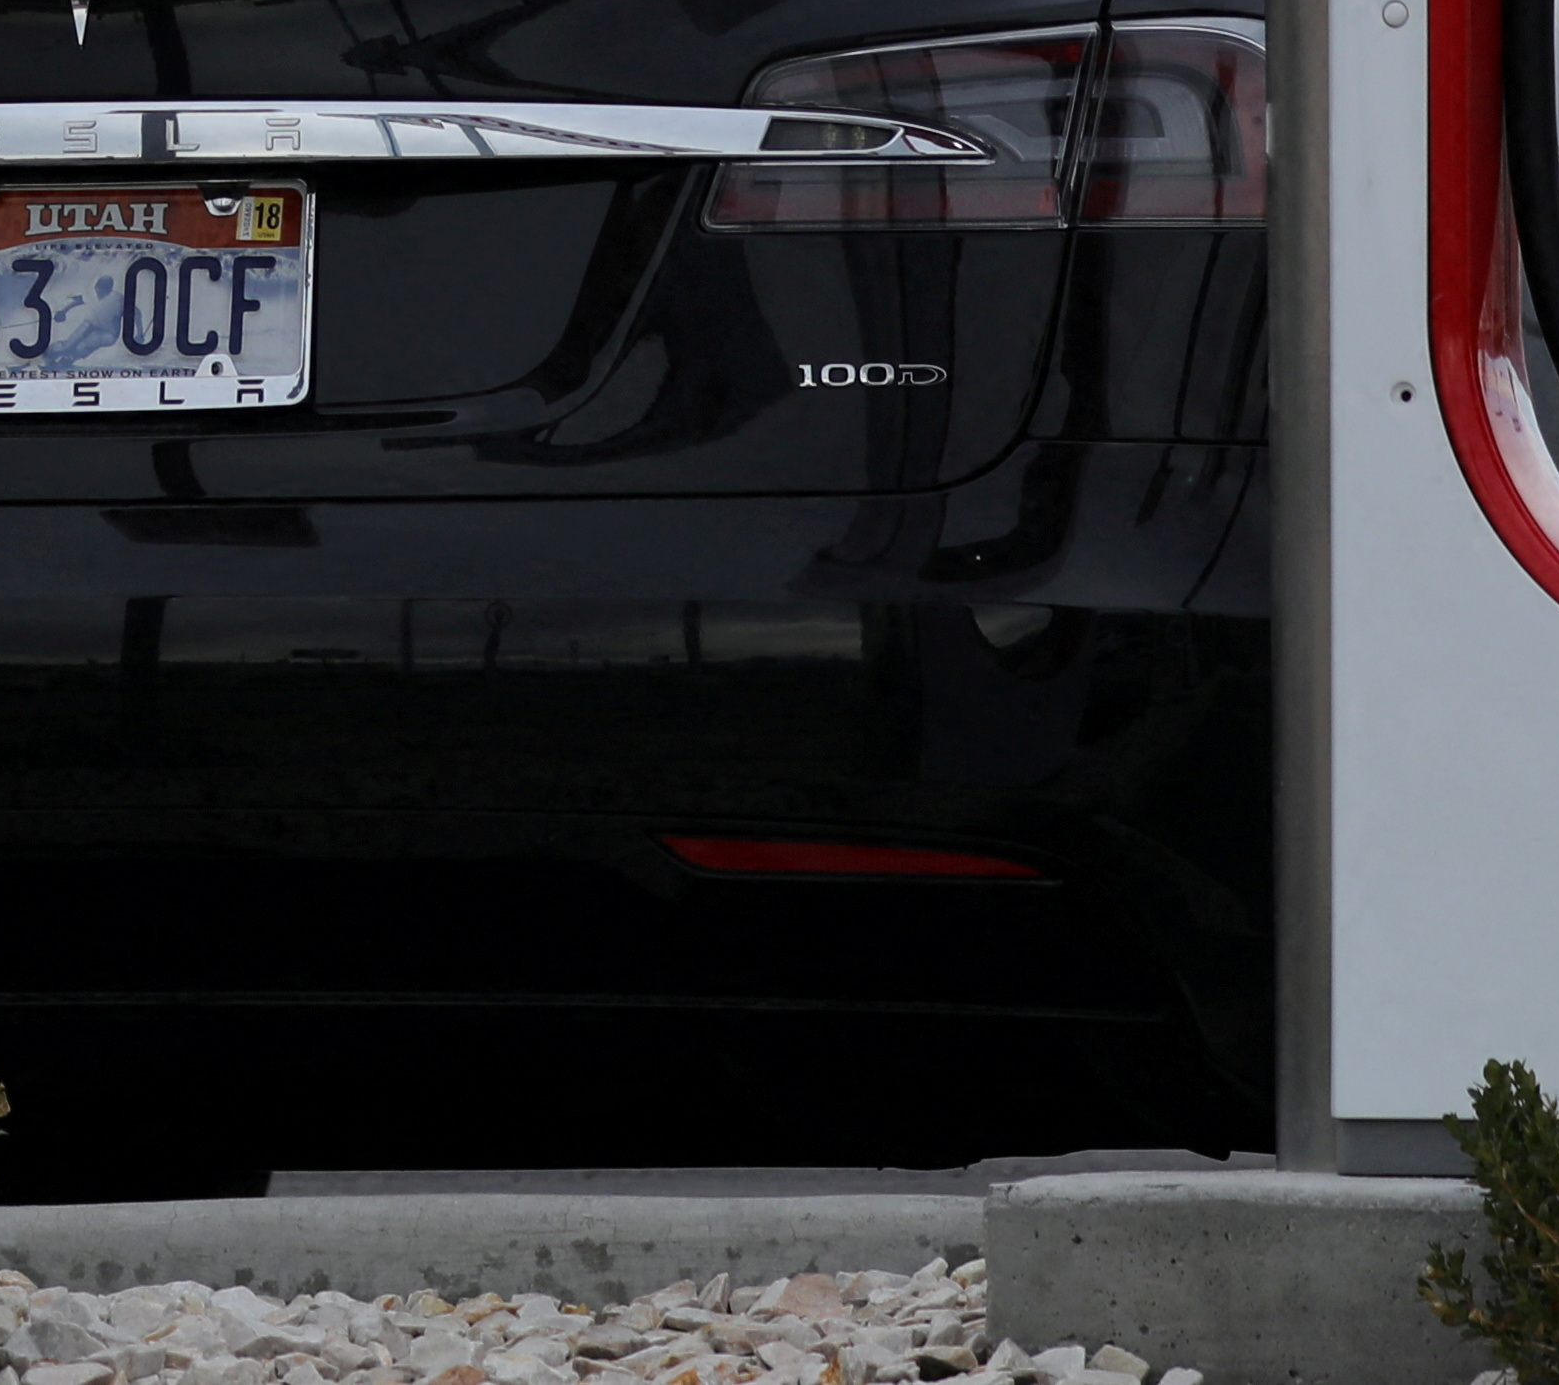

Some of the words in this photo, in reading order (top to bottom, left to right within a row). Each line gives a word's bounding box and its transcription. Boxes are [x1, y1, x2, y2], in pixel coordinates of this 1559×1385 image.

[24, 202, 170, 237] UTAH
[255, 202, 281, 230] 18
[34, 243, 67, 251] LIFE
[75, 242, 155, 250] ELEVATED
[66, 368, 114, 379] SNOW
[120, 368, 143, 378] ON
[798, 362, 948, 388] 100D
